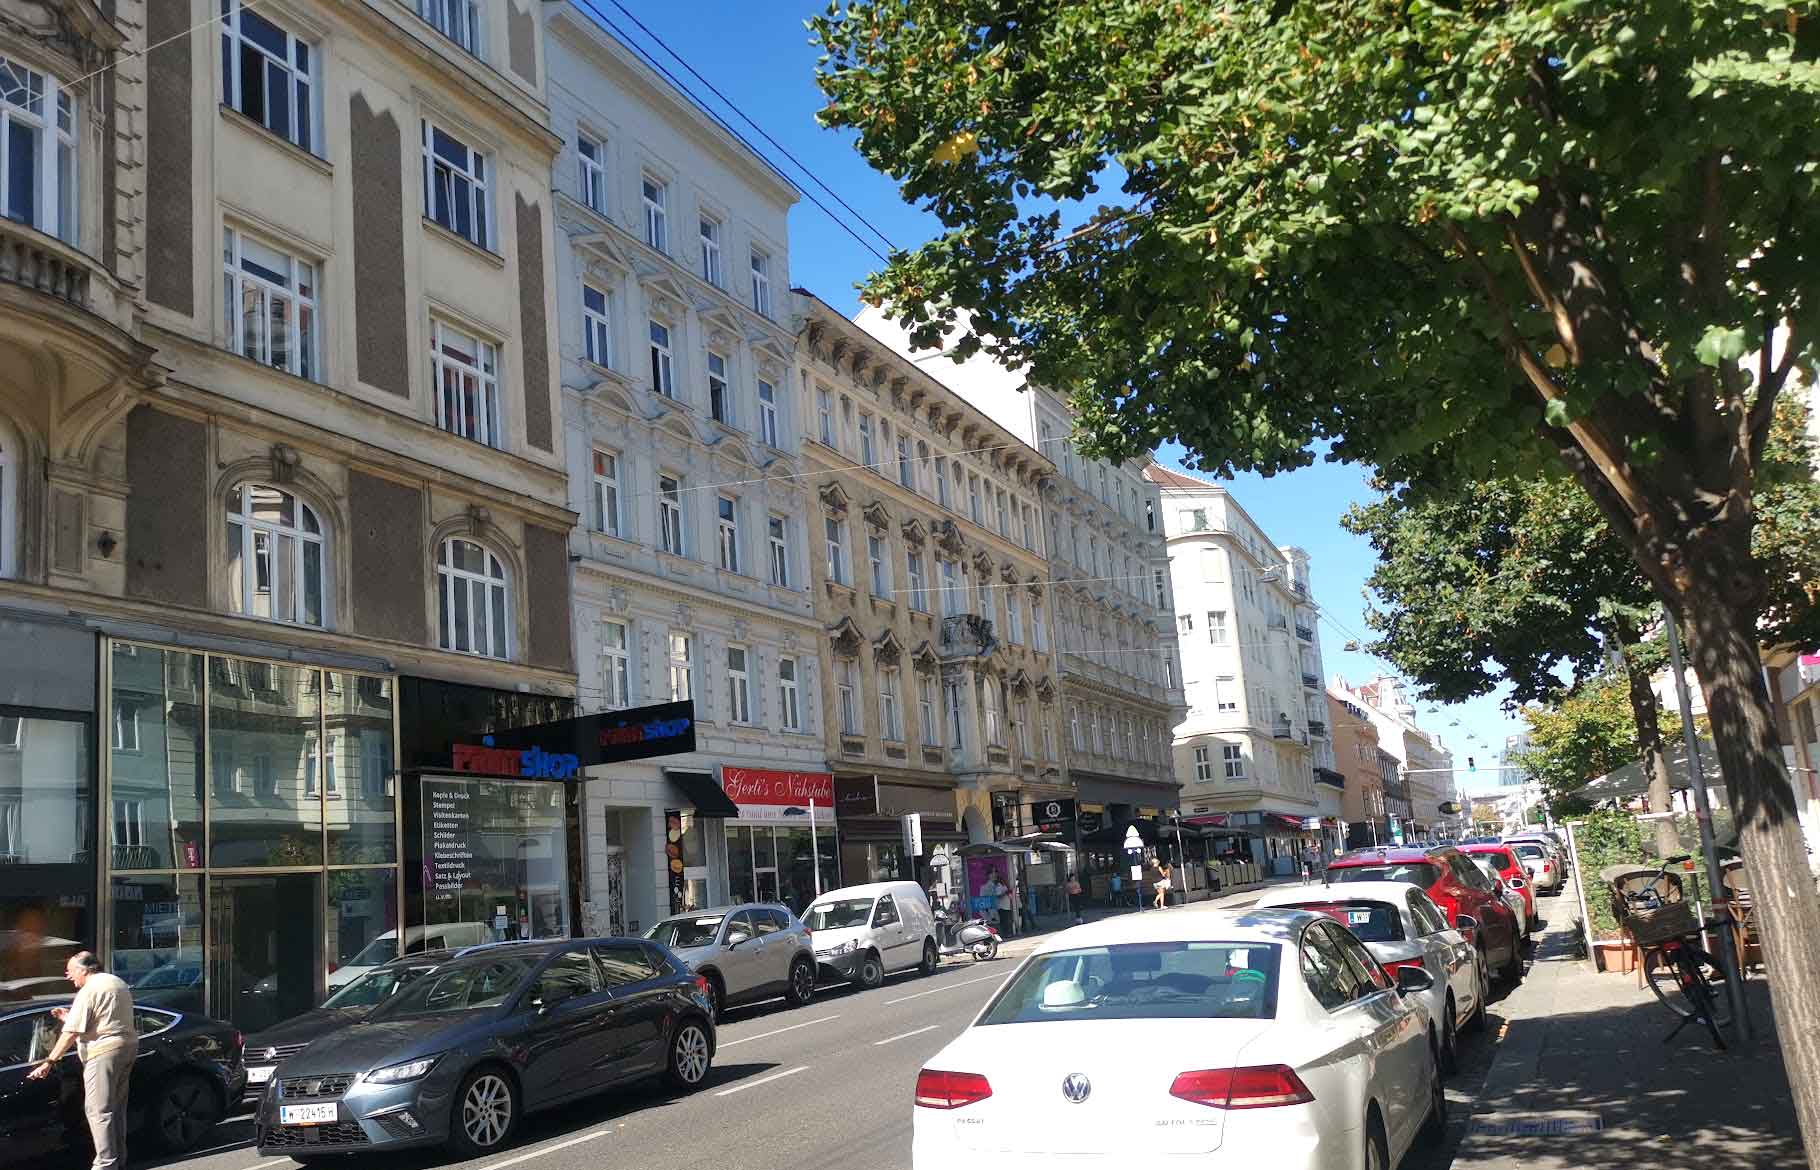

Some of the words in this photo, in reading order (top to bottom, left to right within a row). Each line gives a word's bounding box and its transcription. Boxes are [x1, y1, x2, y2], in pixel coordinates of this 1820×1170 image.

[433, 801, 456, 810] Stempel
[433, 811, 470, 819] Visitenkarten
[434, 821, 459, 829] Etiketten
[434, 831, 456, 839] Schilder
[435, 861, 465, 869] Textildruck
[435, 872, 447, 880] Satz
[453, 871, 472, 881] Layout
[436, 882, 464, 890] Passbilder
